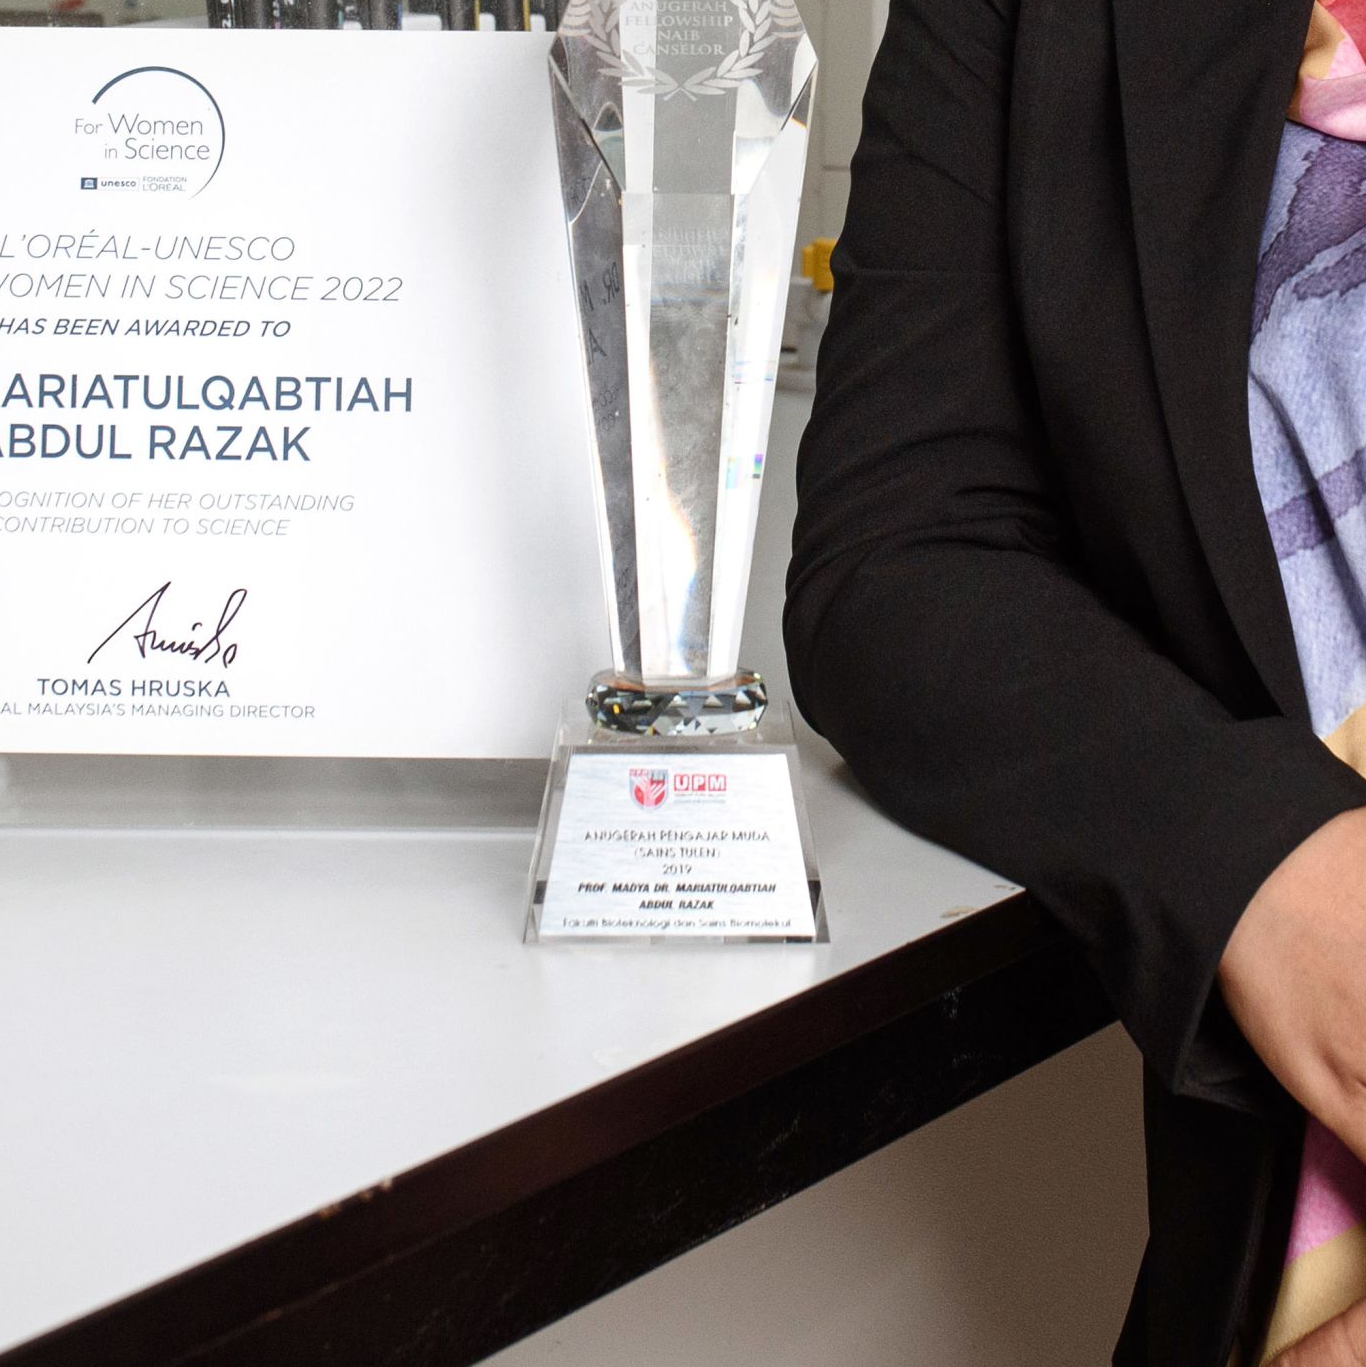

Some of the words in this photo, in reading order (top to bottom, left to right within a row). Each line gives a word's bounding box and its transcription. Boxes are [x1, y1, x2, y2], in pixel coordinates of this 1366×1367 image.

[625, 15, 734, 27] FELLOWSHIP
[74, 118, 104, 135] For
[108, 113, 203, 136] Women
[104, 143, 118, 160] in
[124, 136, 211, 161] Science
[100, 179, 137, 188] unesco
[120, 275, 156, 300] IN
[164, 275, 311, 302] SCIENCE
[320, 277, 404, 303] 2022
[53, 319, 120, 337] BEEN
[125, 319, 251, 339] AWARDED
[260, 321, 292, 339] TO
[148, 425, 311, 463] RAZAK
[112, 493, 142, 510] OF
[148, 493, 192, 511] HER
[198, 493, 355, 513] OUTSTANDING
[164, 518, 190, 537] TO
[196, 519, 291, 537] SCIENCE
[36, 679, 122, 698] TOMAS
[131, 680, 231, 699] HRUSKA
[27, 703, 126, 718] MALAYSIA'S
[131, 704, 224, 719] MANAGING
[229, 706, 316, 720] DIRECTOR
[673, 774, 727, 792] UPM
[584, 829, 656, 842] ANUGERAH
[660, 830, 728, 842] PENGAJAR
[731, 830, 771, 842] MUDA
[662, 864, 693, 876] 2019
[611, 883, 650, 894] MADYA
[638, 899, 674, 910] ABDUL
[678, 900, 715, 910] RAZAK
